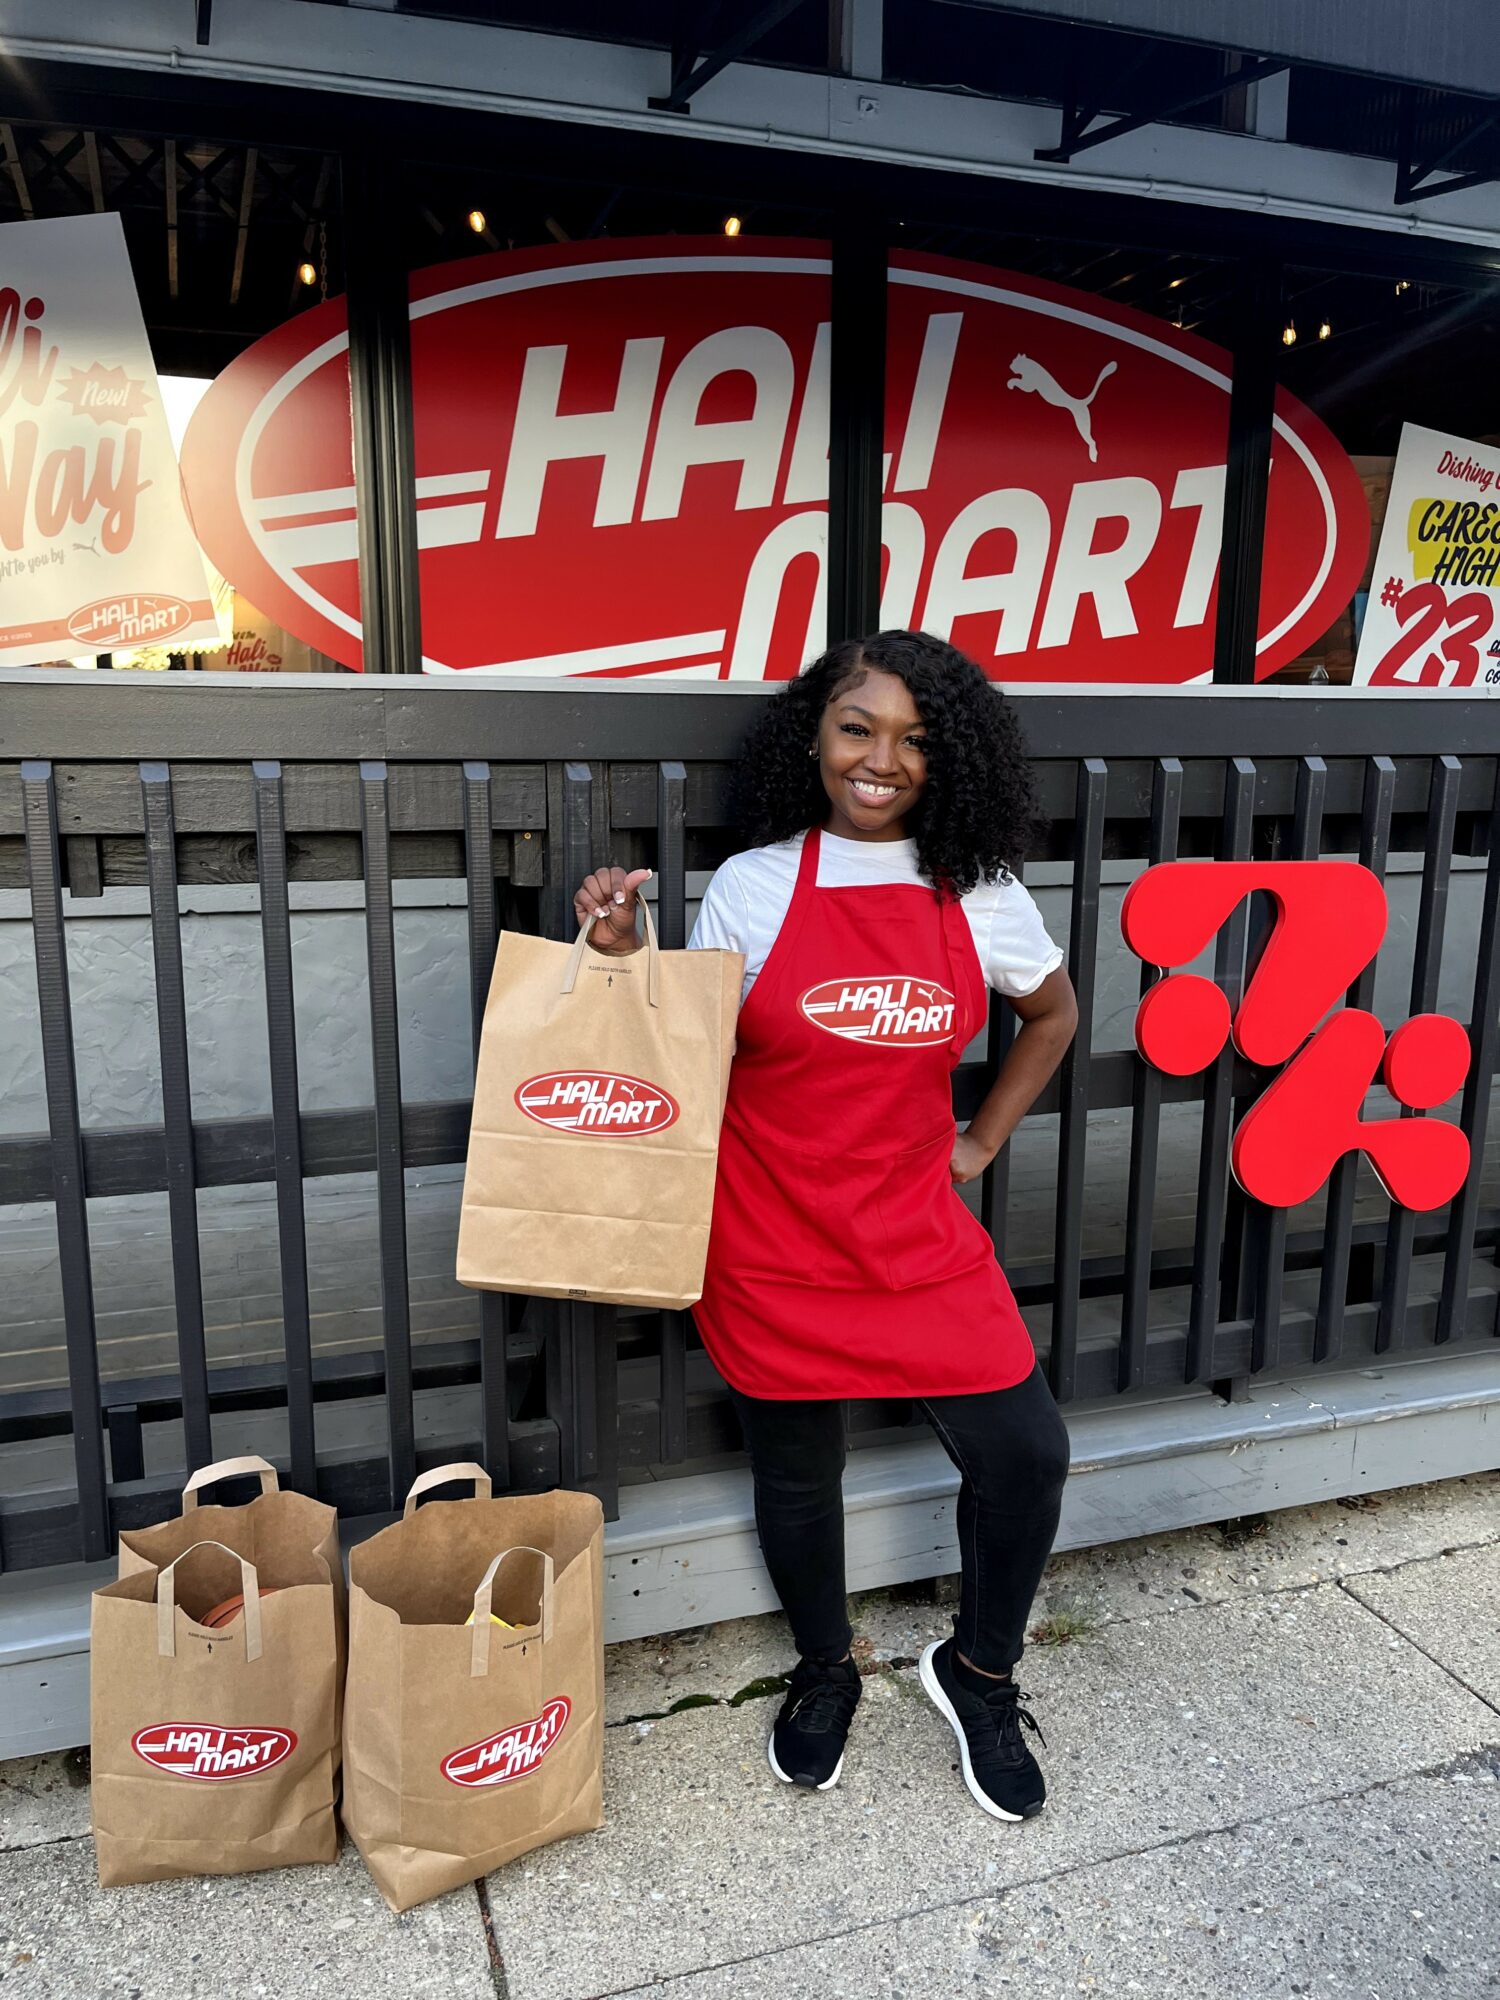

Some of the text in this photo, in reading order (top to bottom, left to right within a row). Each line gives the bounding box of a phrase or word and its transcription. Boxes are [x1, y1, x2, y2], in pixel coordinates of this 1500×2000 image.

[80, 381, 132, 406] New!
[495, 311, 964, 539] HALI
[1437, 450, 1495, 492] Dishing
[28, 552, 49, 574] you
[50, 547, 65, 565] by
[1431, 545, 1500, 588] HIGH
[92, 598, 139, 630] HALI
[120, 604, 180, 641] MART
[227, 637, 267, 665] Hali
[837, 981, 911, 1013] HALI
[870, 1004, 956, 1036] MART
[549, 1079, 616, 1105] HALI
[577, 1100, 662, 1126] MART
[165, 1731, 227, 1753] HALI
[193, 1737, 279, 1773] MART
[476, 1723, 537, 1771] HALI
